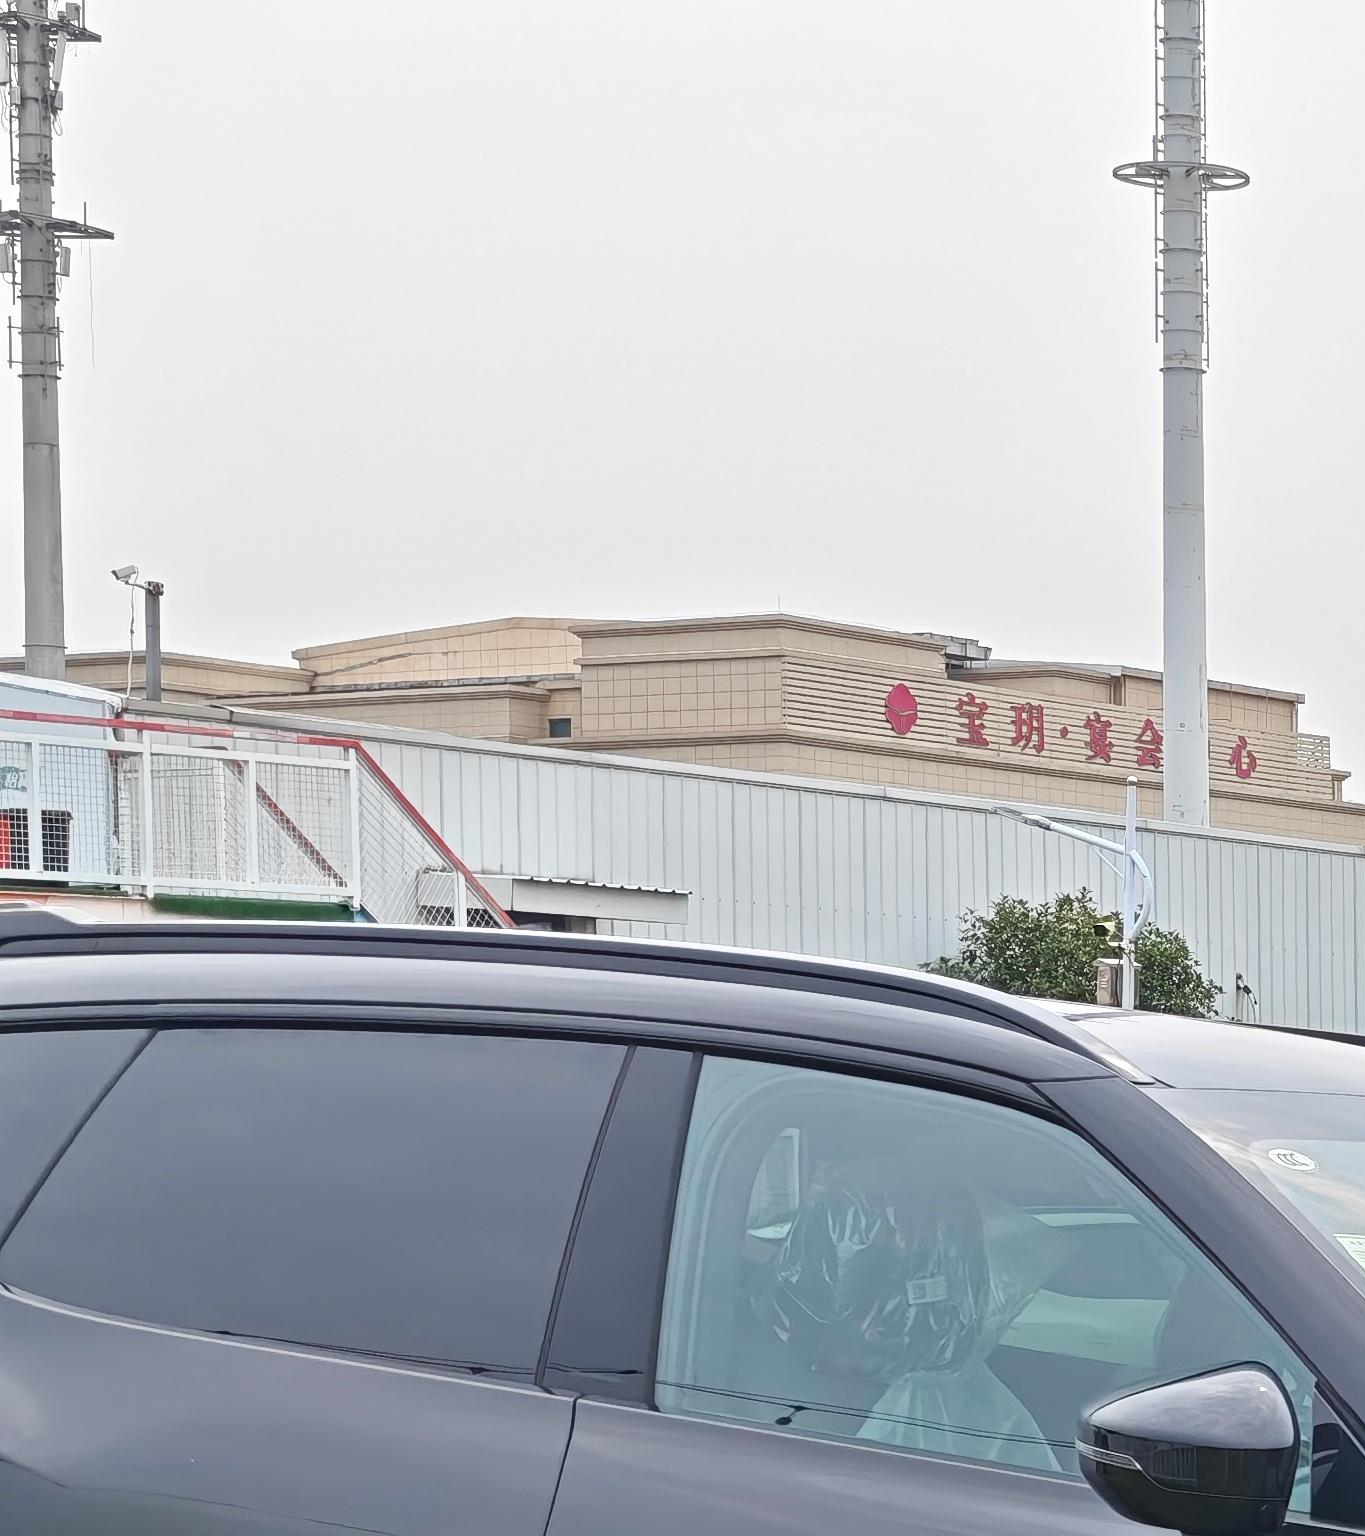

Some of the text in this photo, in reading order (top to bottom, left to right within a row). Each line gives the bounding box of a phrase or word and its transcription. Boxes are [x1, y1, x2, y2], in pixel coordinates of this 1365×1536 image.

[955, 692, 1257, 779] 宝玥·宴会心
